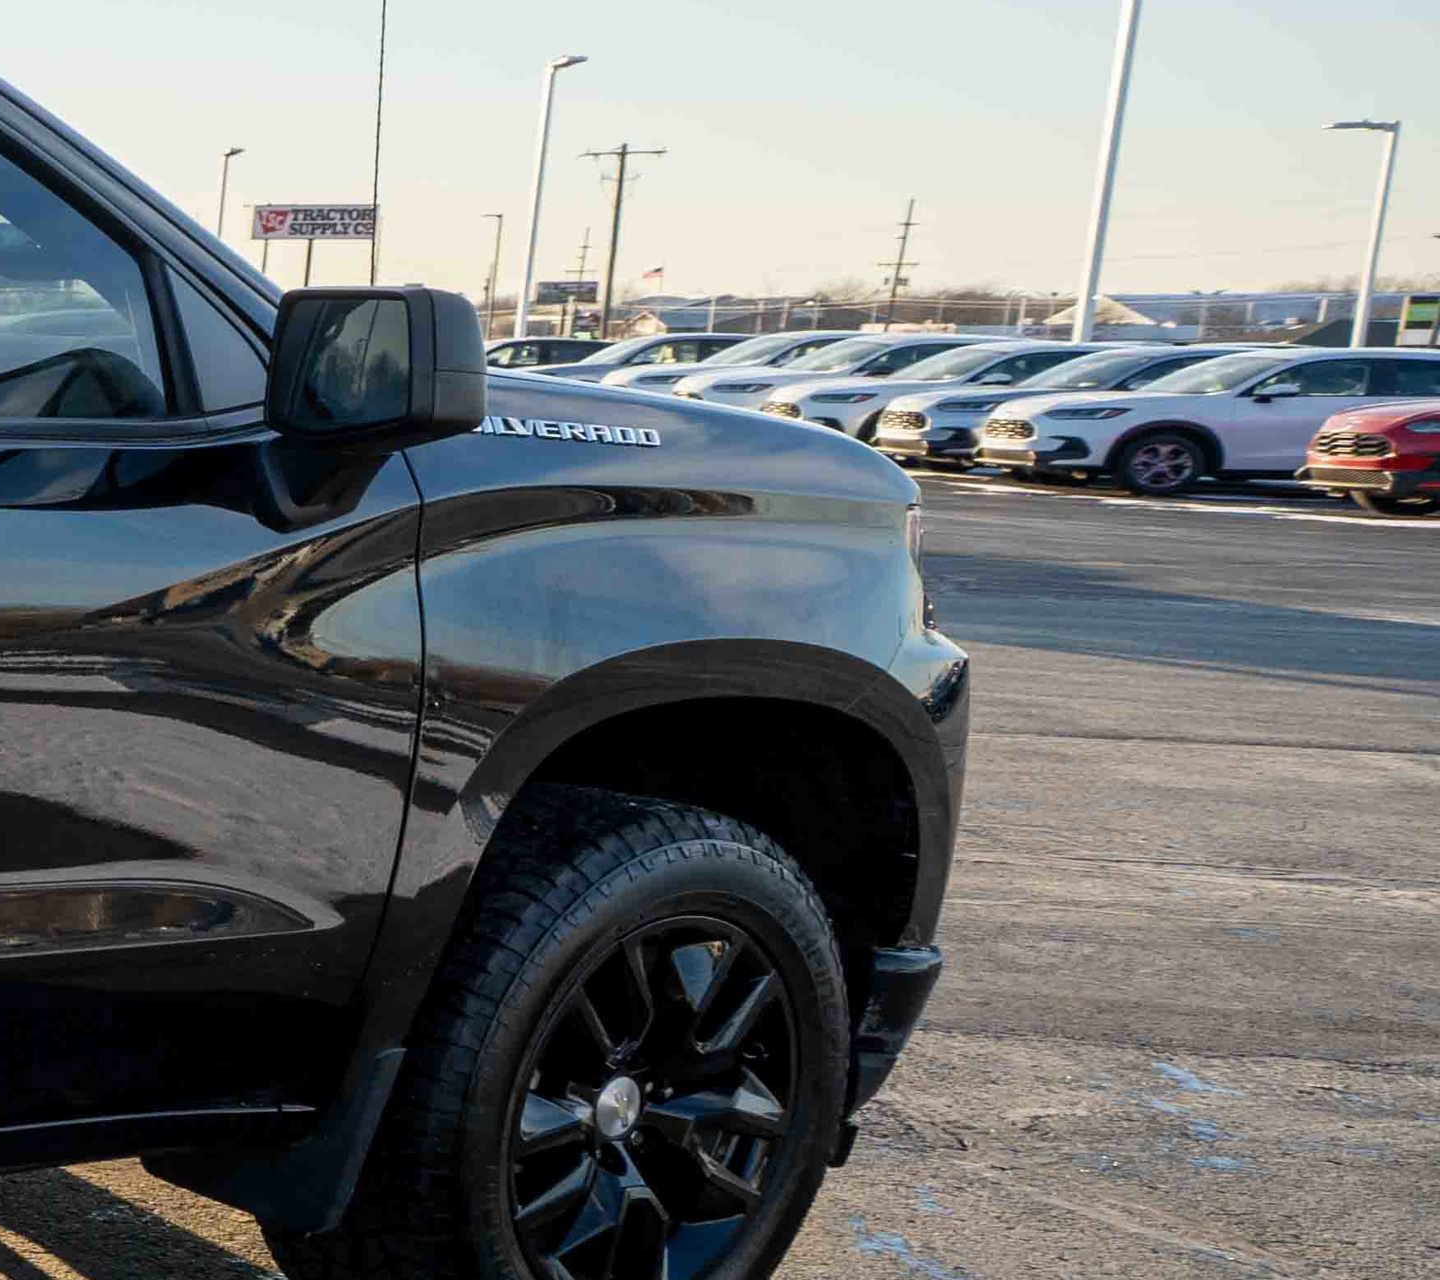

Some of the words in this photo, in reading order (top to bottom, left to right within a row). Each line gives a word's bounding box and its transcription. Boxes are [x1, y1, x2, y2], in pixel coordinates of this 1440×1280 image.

[291, 208, 374, 221] TRACTOR
[289, 222, 352, 235] SUPPLY
[472, 415, 661, 447] ILVERADO
